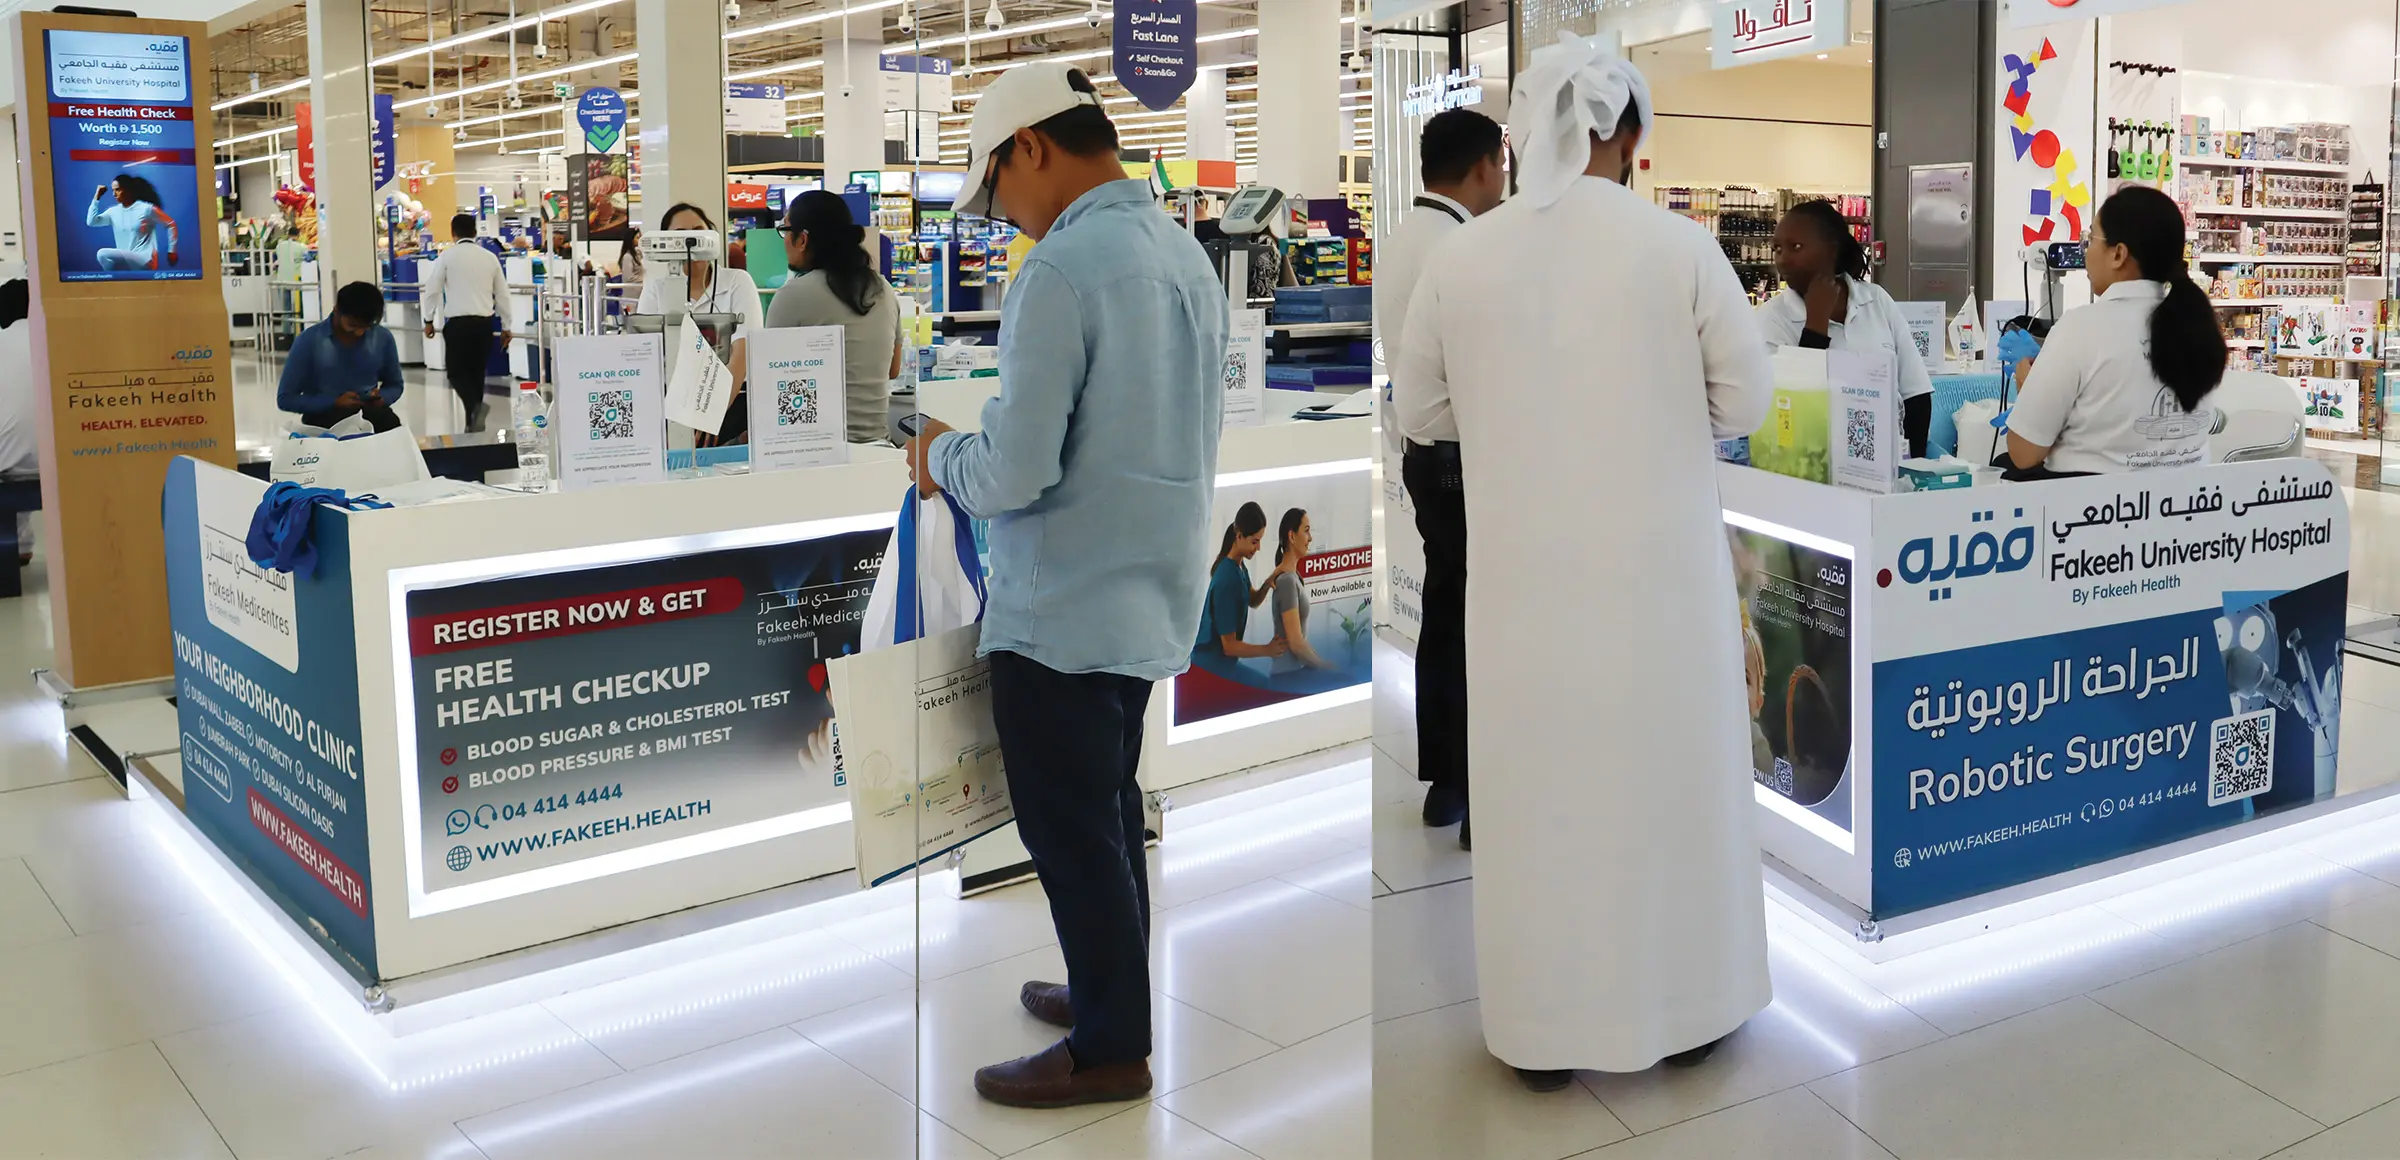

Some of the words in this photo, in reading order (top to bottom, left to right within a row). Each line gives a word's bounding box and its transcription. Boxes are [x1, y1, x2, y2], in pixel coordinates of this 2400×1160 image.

[1130, 12, 1156, 24] السريع
[1156, 12, 1181, 25] المسار
[1132, 29, 1154, 42] Fast
[1155, 31, 1179, 43] Lane
[58, 59, 99, 70] الجامعي
[101, 61, 128, 71] فقيه
[130, 61, 180, 72] مستشفى
[933, 59, 947, 73] 31
[1136, 54, 1150, 63] Self
[1150, 55, 1184, 65] Checkout
[59, 75, 93, 85] Fakeeh
[97, 77, 141, 88] University
[143, 79, 181, 89] Hospital
[1144, 67, 1177, 77] Scan&Go
[764, 86, 780, 99] 32
[68, 105, 95, 116] Free
[97, 106, 137, 118] Health
[139, 107, 176, 119] Check
[79, 122, 117, 133] Worth
[131, 124, 163, 134] 1,500
[99, 138, 131, 146] Register
[731, 189, 762, 202] عروض
[231, 278, 242, 287] 01
[578, 371, 602, 380] SCAN
[604, 370, 616, 379] QR
[618, 368, 641, 377] CODE
[768, 361, 790, 369] SCAN
[791, 360, 802, 368] QR
[804, 358, 824, 366] CODE
[148, 372, 215, 386] فقيه
[69, 390, 142, 409] Fakeeh
[151, 388, 216, 404] Health
[1841, 386, 1856, 395] SCAN
[1856, 388, 1865, 396] QR
[1865, 389, 1880, 398] CODE
[2319, 406, 2328, 417] 10
[81, 419, 137, 432] HEALTH.
[140, 415, 208, 429] ELEVATED.
[2126, 450, 2158, 459] الجامعي
[2159, 485, 2223, 524] فقيه
[2231, 475, 2334, 517] مستشفى
[2052, 490, 2150, 545] الجامعي
[2050, 545, 2133, 582] Fakeeh
[2140, 533, 2247, 570] University
[2251, 518, 2332, 554] Hospital
[1305, 550, 1372, 574] PHYSIOTHE
[1310, 586, 1329, 598] Now
[1330, 580, 1366, 594] Available
[1756, 581, 1784, 597] الجامعي
[1785, 588, 1806, 603] فقيه
[2072, 588, 2089, 605] By
[2092, 580, 2138, 601] Fakeeh
[2141, 574, 2181, 592] Health
[208, 573, 236, 607] Fakeeh
[237, 589, 290, 636] Medicentres
[757, 594, 809, 616] سنترز
[1806, 596, 1845, 617] مستشفى
[433, 610, 560, 645] REGISTER
[567, 599, 631, 627] NOW
[638, 597, 656, 615] &
[661, 588, 707, 612] GET
[757, 615, 808, 635] Fakeeh
[1756, 597, 1779, 614] Fakeeh
[1780, 605, 1814, 629] University
[1815, 617, 1845, 638] Hospital
[757, 638, 767, 646] By
[768, 634, 792, 644] Fakeeh
[794, 630, 816, 640] Health
[434, 658, 514, 693] FREE
[2081, 636, 2200, 700] الجراحة
[174, 630, 203, 674] YOUR
[205, 649, 303, 742] NEIGHBORHOOD
[307, 719, 358, 780] CLINIC
[436, 685, 562, 728] HEALTH
[571, 662, 711, 705] CHECKUP
[1906, 659, 2072, 739] الروبوتية
[191, 686, 208, 710] DUBAI
[224, 710, 246, 739] ZABEEL
[467, 736, 534, 761] BLOOD
[539, 723, 603, 749] SUGAR
[608, 720, 622, 736] &
[625, 701, 747, 733] CHOLESTEROL
[750, 690, 791, 711] TEST
[234, 745, 251, 772] PARK
[255, 733, 294, 774] MOTORCITY
[468, 764, 536, 789] BLOOD
[540, 747, 635, 776] PRESSURE
[638, 741, 652, 757] &
[656, 735, 687, 754] BMI
[691, 727, 732, 746] TEST
[194, 748, 202, 767] 04
[203, 756, 213, 777] 414
[214, 766, 229, 790] 4444
[1908, 750, 2054, 812] Robotic
[2065, 720, 2198, 775] Surgery
[1765, 773, 1774, 787] US
[261, 768, 282, 798] DUBAI
[282, 785, 310, 820] SILICON
[311, 807, 335, 839] OASIS
[306, 772, 316, 792] AL
[317, 779, 347, 815] FURJAN
[502, 804, 528, 822] 04
[533, 794, 569, 815] 414
[574, 782, 624, 807] 4444
[2119, 798, 2136, 812] 04
[2138, 790, 2163, 807] 414
[2166, 781, 2198, 800] 4444
[477, 799, 712, 863] WWW.FAKEEH.HEALTH
[1917, 811, 2073, 862] WWW.FAKEEH.HEALTH
[250, 796, 362, 908] WWW.FAKEEH.HEALTH
